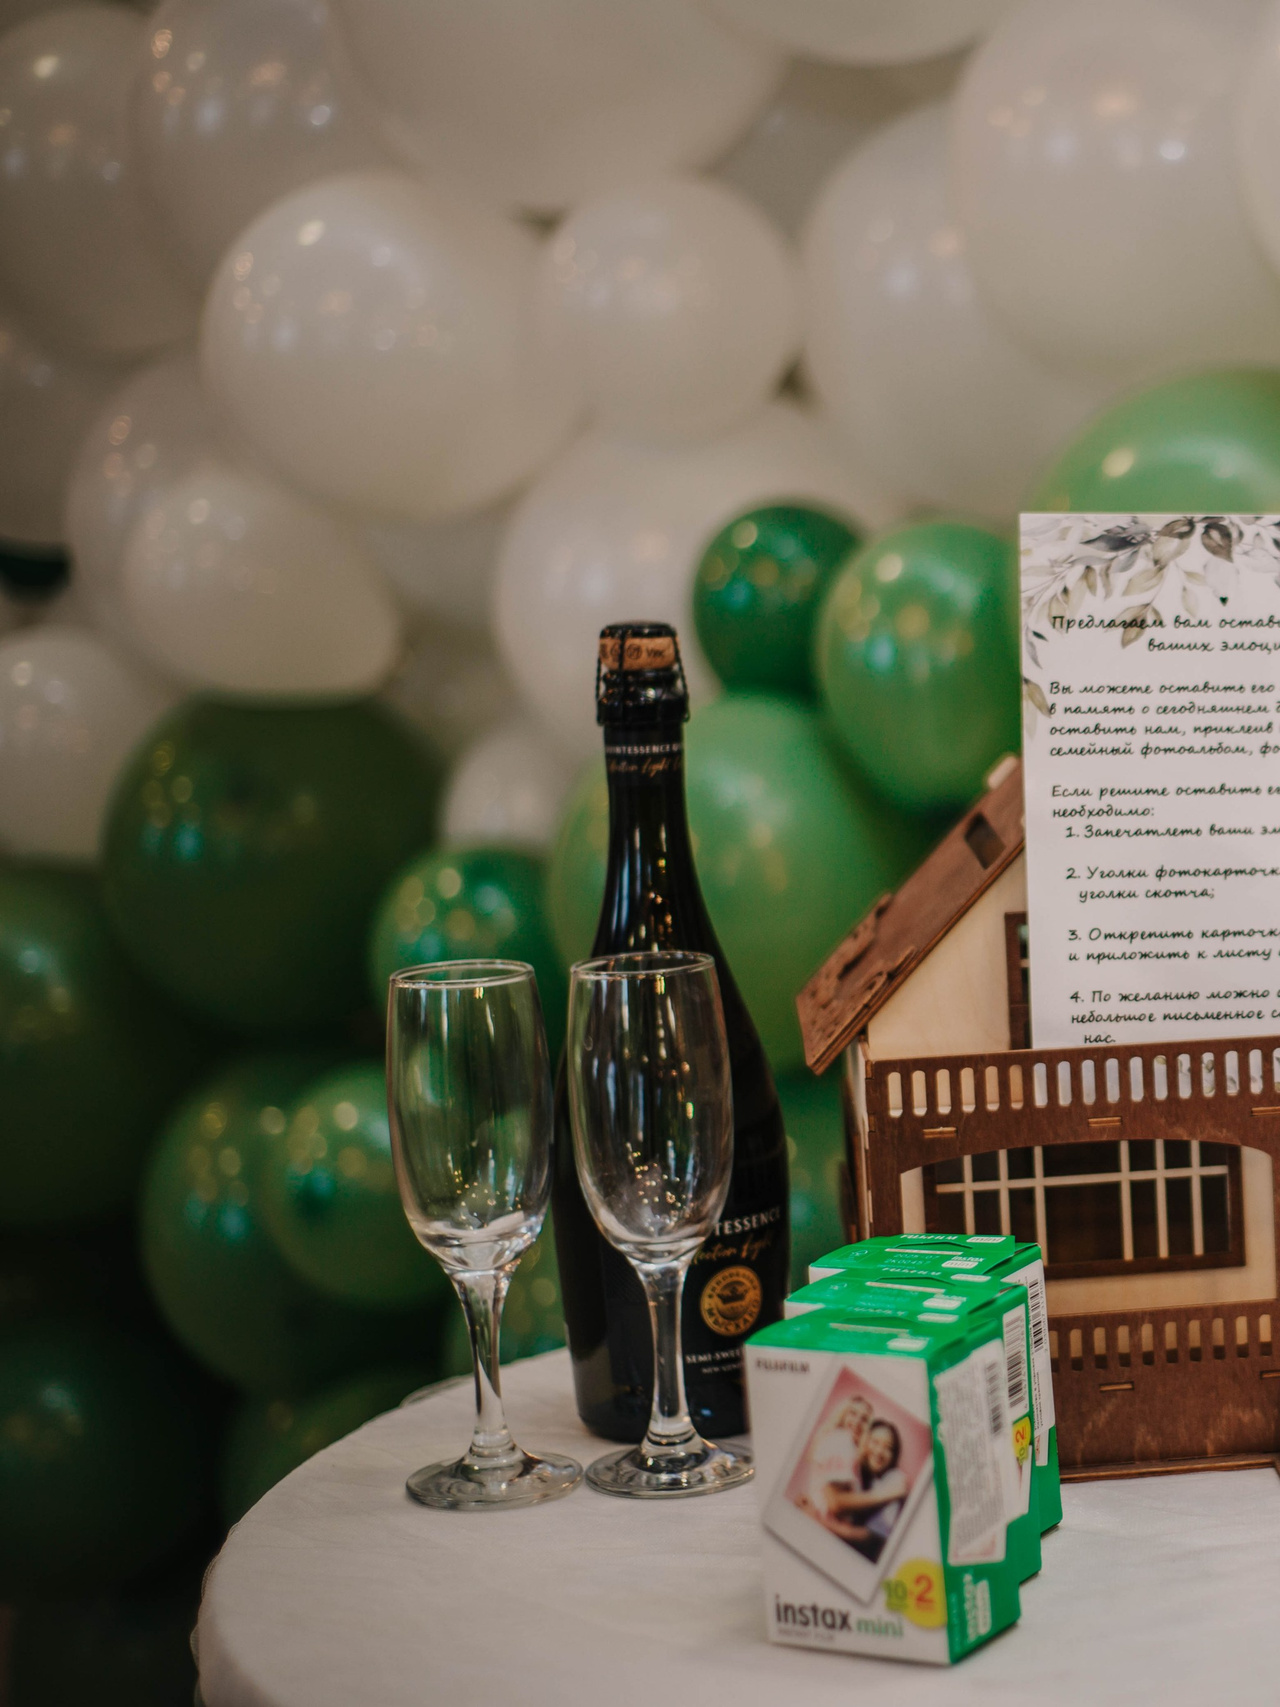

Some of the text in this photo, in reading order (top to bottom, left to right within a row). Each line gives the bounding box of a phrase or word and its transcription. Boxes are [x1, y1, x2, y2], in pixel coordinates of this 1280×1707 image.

[1051, 615, 1166, 633] Предлагаем
[1173, 614, 1212, 629] вам
[1147, 637, 1215, 652] ваших
[1049, 680, 1074, 695] Вы
[1078, 684, 1154, 695] можете
[1158, 680, 1246, 694] оставить
[1250, 684, 1275, 694] его
[1048, 702, 1057, 717] в
[1063, 705, 1136, 715] память
[1141, 705, 1150, 715] о
[1155, 700, 1270, 715] сегодняшнем
[1049, 722, 1137, 736] оставить
[1144, 725, 1186, 737] нам,
[1193, 721, 1274, 738] приклеив
[1049, 742, 1135, 757] семейный
[1140, 741, 1253, 759] фотоальбом,
[1051, 784, 1093, 798] Если
[1098, 786, 1170, 801] решите
[1175, 782, 1263, 796] оставить
[1052, 803, 1155, 820] необходимо:
[1065, 826, 1080, 839] 1.
[1083, 823, 1203, 839] Запечатлеть
[1208, 823, 1255, 837] ваши
[1065, 867, 1081, 880] 2.
[1086, 865, 1149, 880] Уголки
[1078, 888, 1215, 904] уголки скотча;
[1068, 929, 1082, 942] 3.
[1088, 927, 1194, 945] Открепить
[1068, 952, 1080, 962] и
[1085, 950, 1190, 965] приложить
[1197, 950, 1208, 960] к
[1212, 948, 1272, 962] листу
[1069, 990, 1085, 1004] 4.
[1091, 989, 1112, 1003] По
[1117, 991, 1201, 1003] желанию
[1205, 989, 1271, 1000] можно
[1071, 1010, 1157, 1024] небольшое
[1162, 1009, 1265, 1022] письменное
[1083, 1034, 1116, 1044] нас.
[713, 1205, 782, 1237] TESSENCE
[774, 1593, 903, 1637] instax mini
